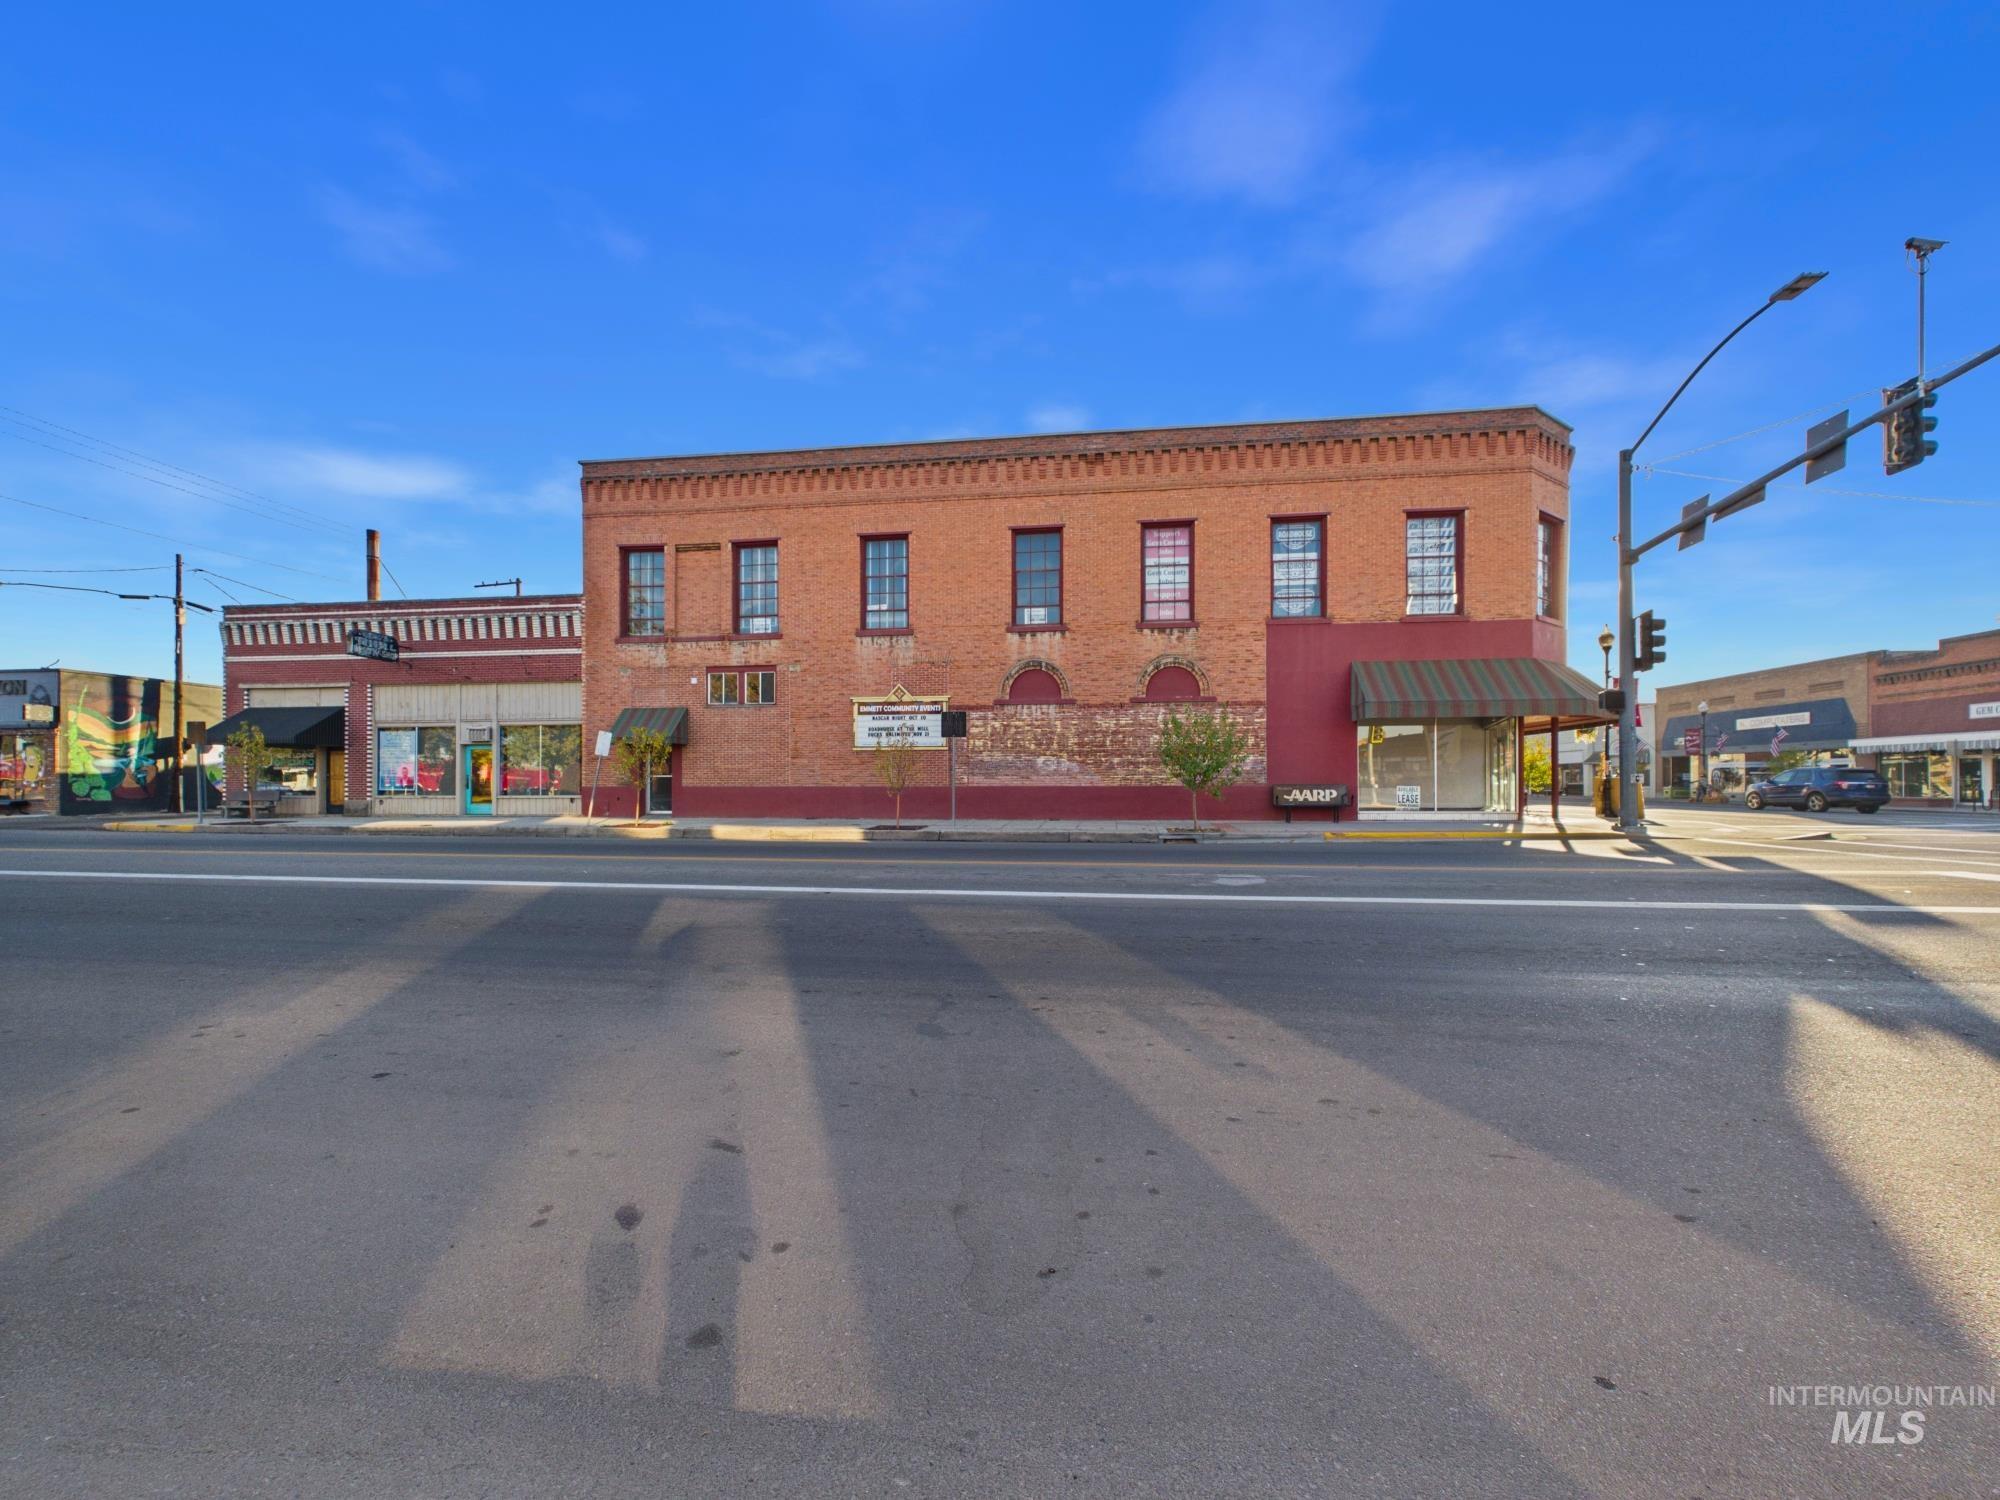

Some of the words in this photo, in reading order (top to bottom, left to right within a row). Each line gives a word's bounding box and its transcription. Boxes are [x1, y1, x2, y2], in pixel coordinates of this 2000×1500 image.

[1976, 706, 1993, 715] GEM
[1283, 789, 1338, 802] AARP
[1397, 794, 1419, 803] LEASE
